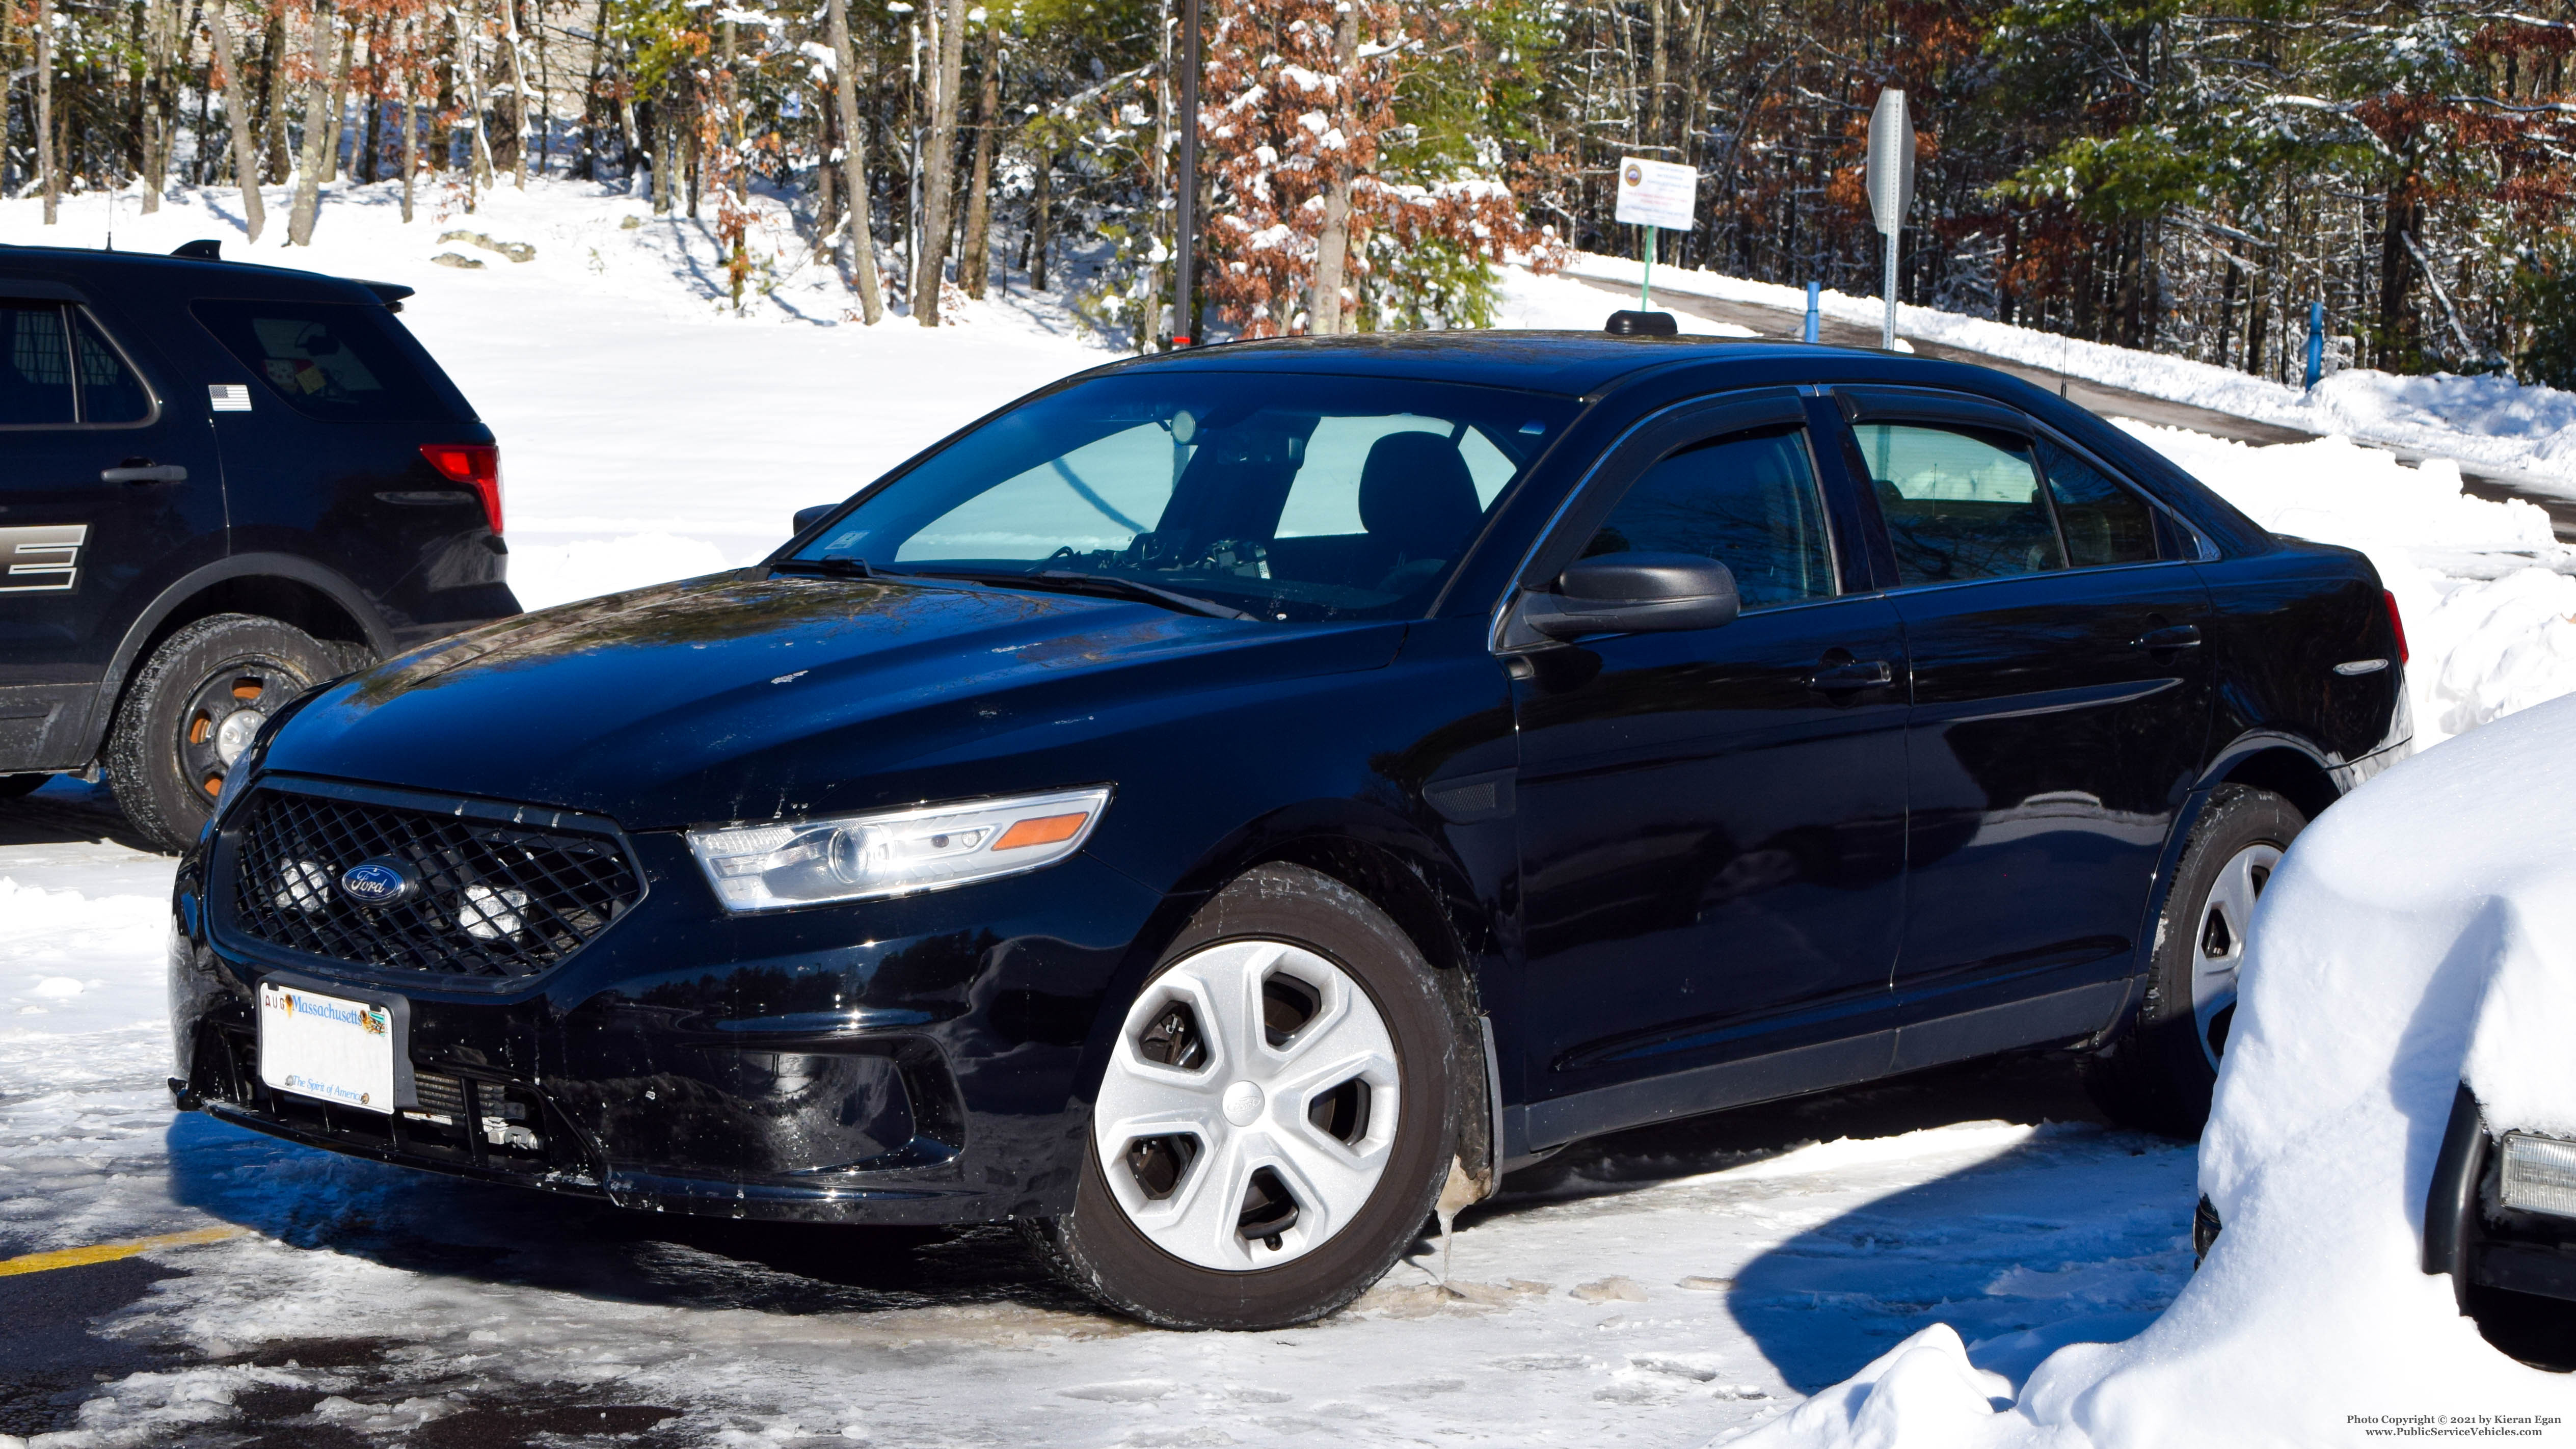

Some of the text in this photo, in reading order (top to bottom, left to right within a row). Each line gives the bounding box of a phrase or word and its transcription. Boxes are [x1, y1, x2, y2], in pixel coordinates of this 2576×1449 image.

[351, 870, 388, 893] Ford
[265, 995, 285, 1010] AUG
[292, 995, 362, 1026] Massachusetts
[293, 1075, 306, 1087] The
[307, 1078, 325, 1091] Spirit
[327, 1084, 334, 1096] of
